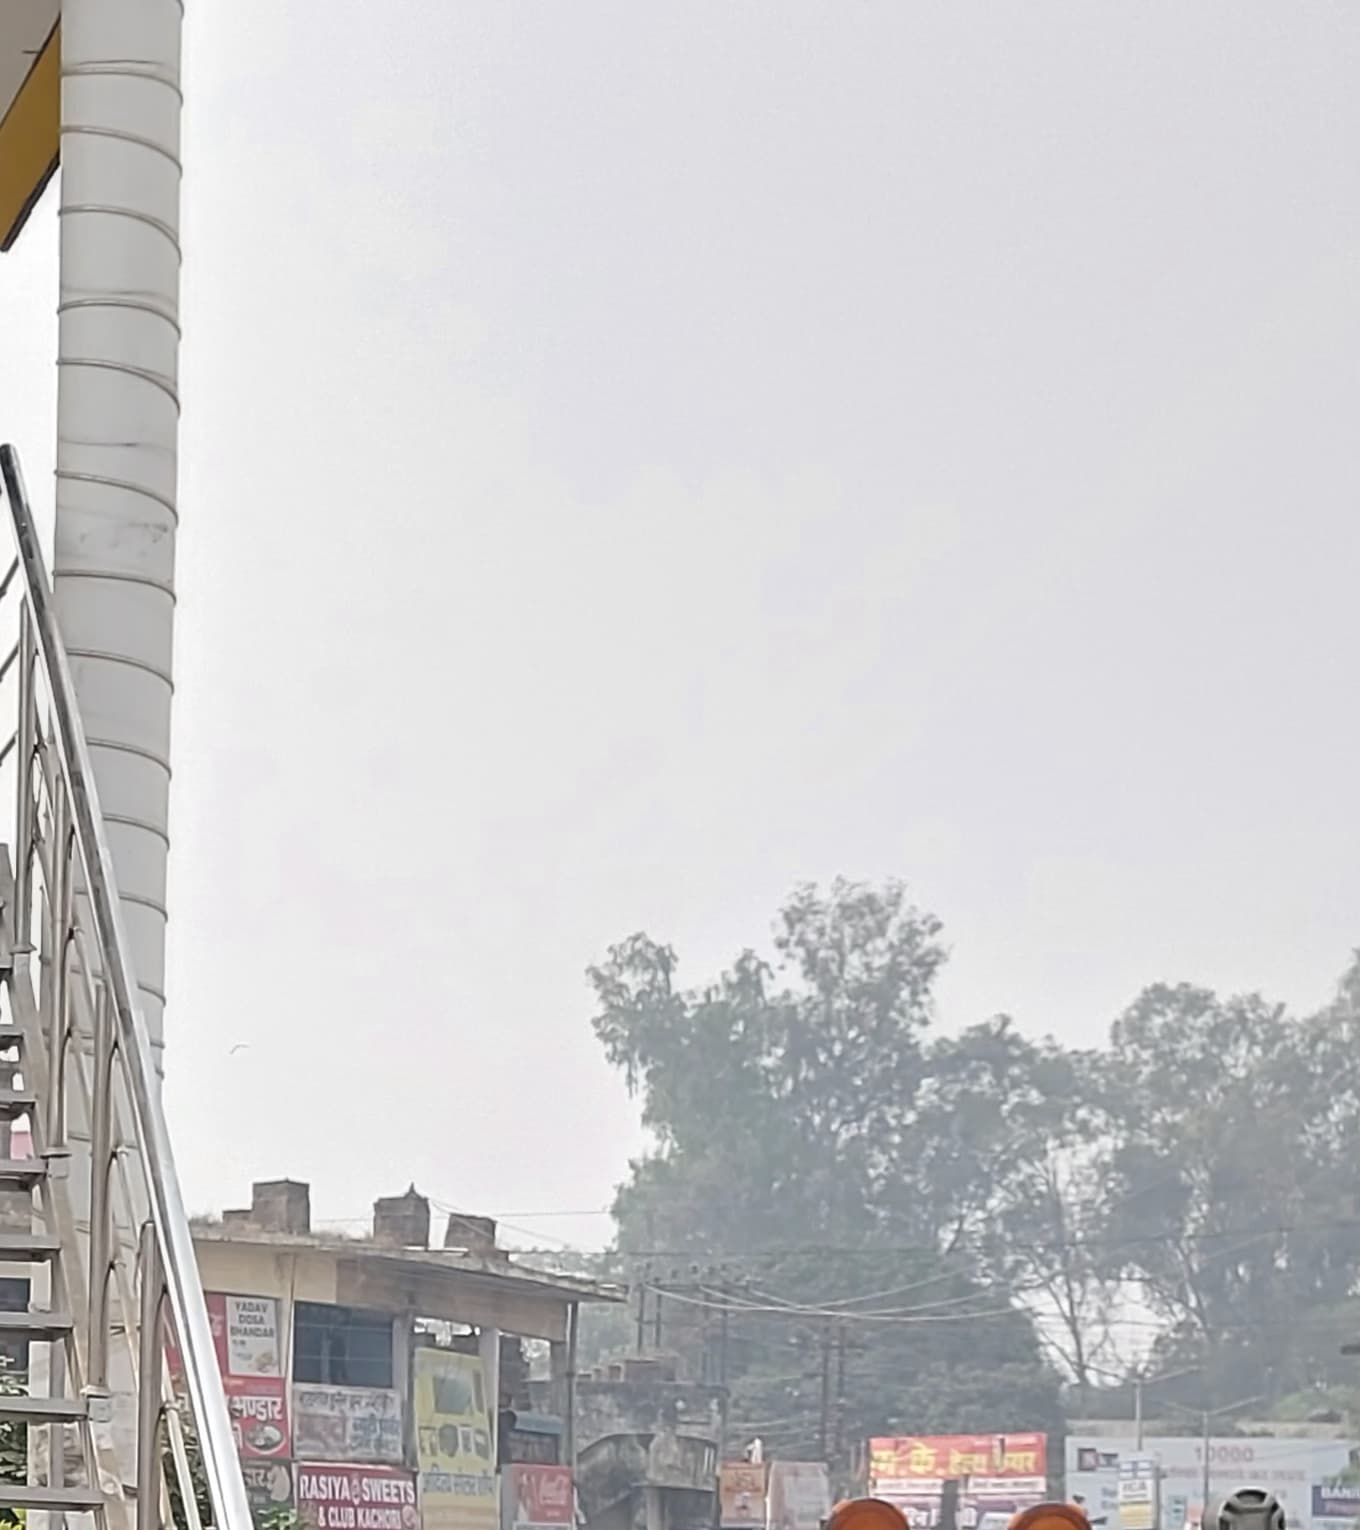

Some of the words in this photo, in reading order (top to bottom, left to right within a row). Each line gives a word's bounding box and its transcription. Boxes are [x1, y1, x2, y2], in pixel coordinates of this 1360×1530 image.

[299, 1475, 351, 1500] RASIYA
[361, 1477, 416, 1504] SWEETS
[318, 1505, 326, 1527] &
[327, 1507, 356, 1528] CLUB
[357, 1508, 402, 1530] KACHORI
